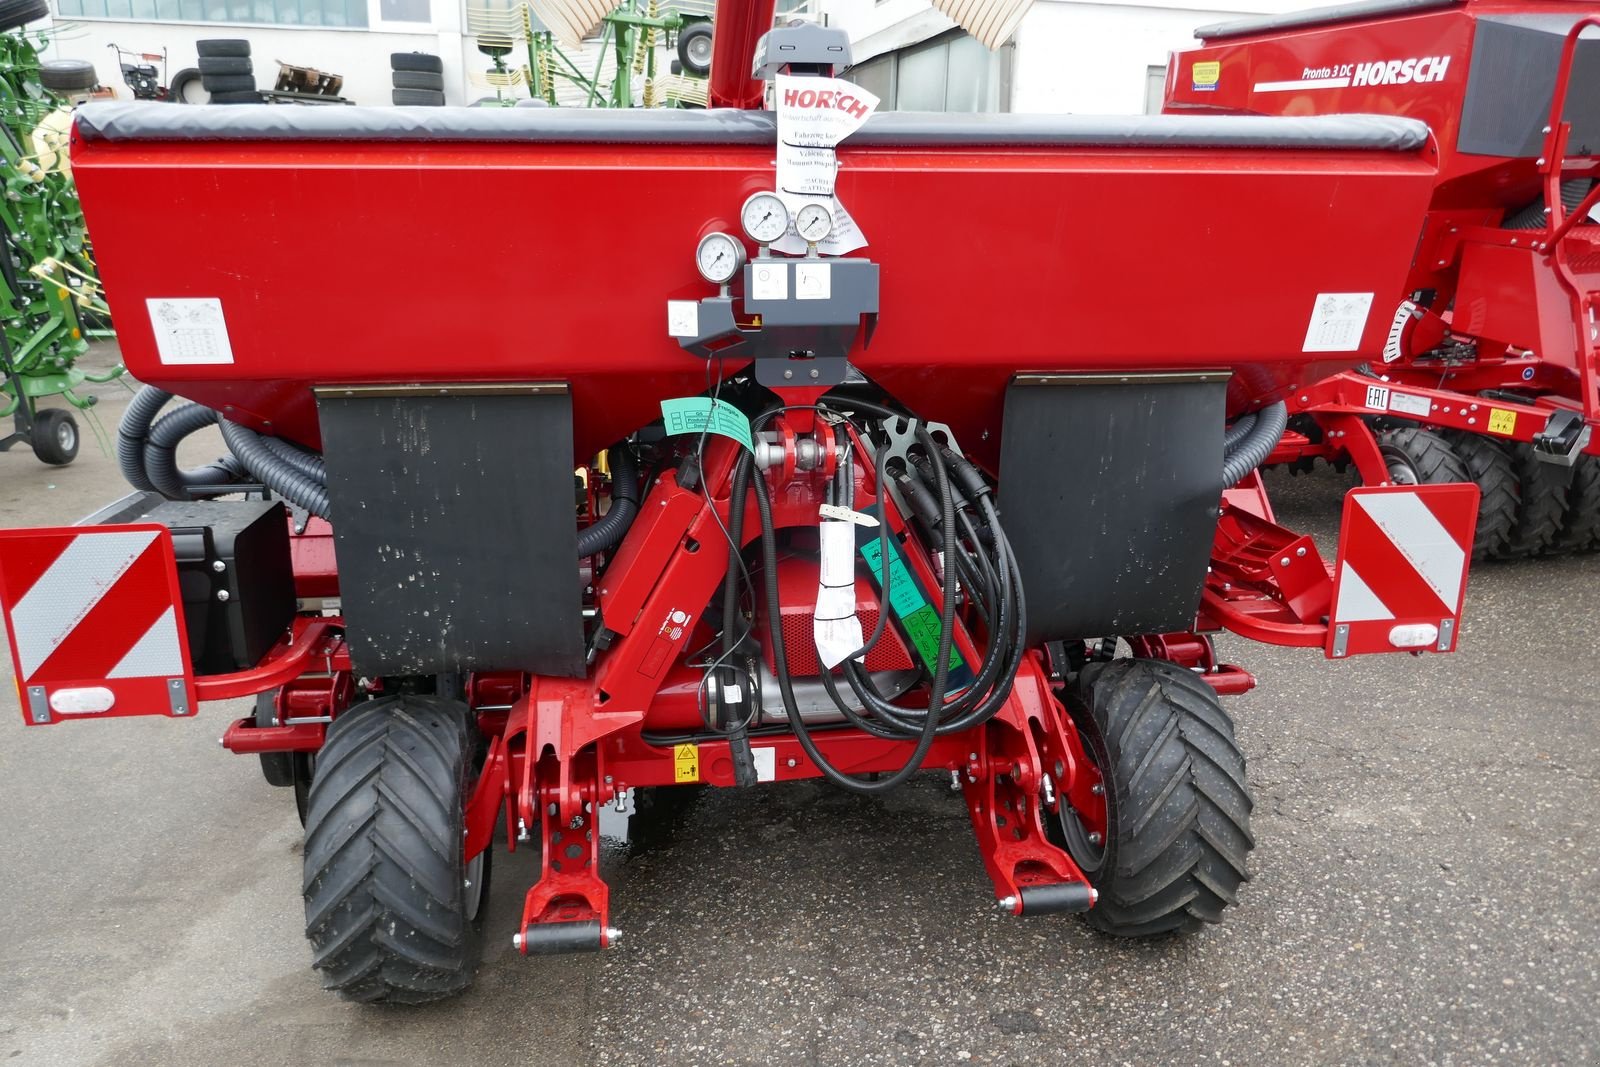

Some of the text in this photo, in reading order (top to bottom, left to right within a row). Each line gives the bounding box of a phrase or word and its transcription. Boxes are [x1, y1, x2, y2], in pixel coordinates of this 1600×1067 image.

[1301, 63, 1354, 80] Pronto 3 DC
[1351, 55, 1451, 87] HORSCH
[1368, 388, 1386, 407] EAC
